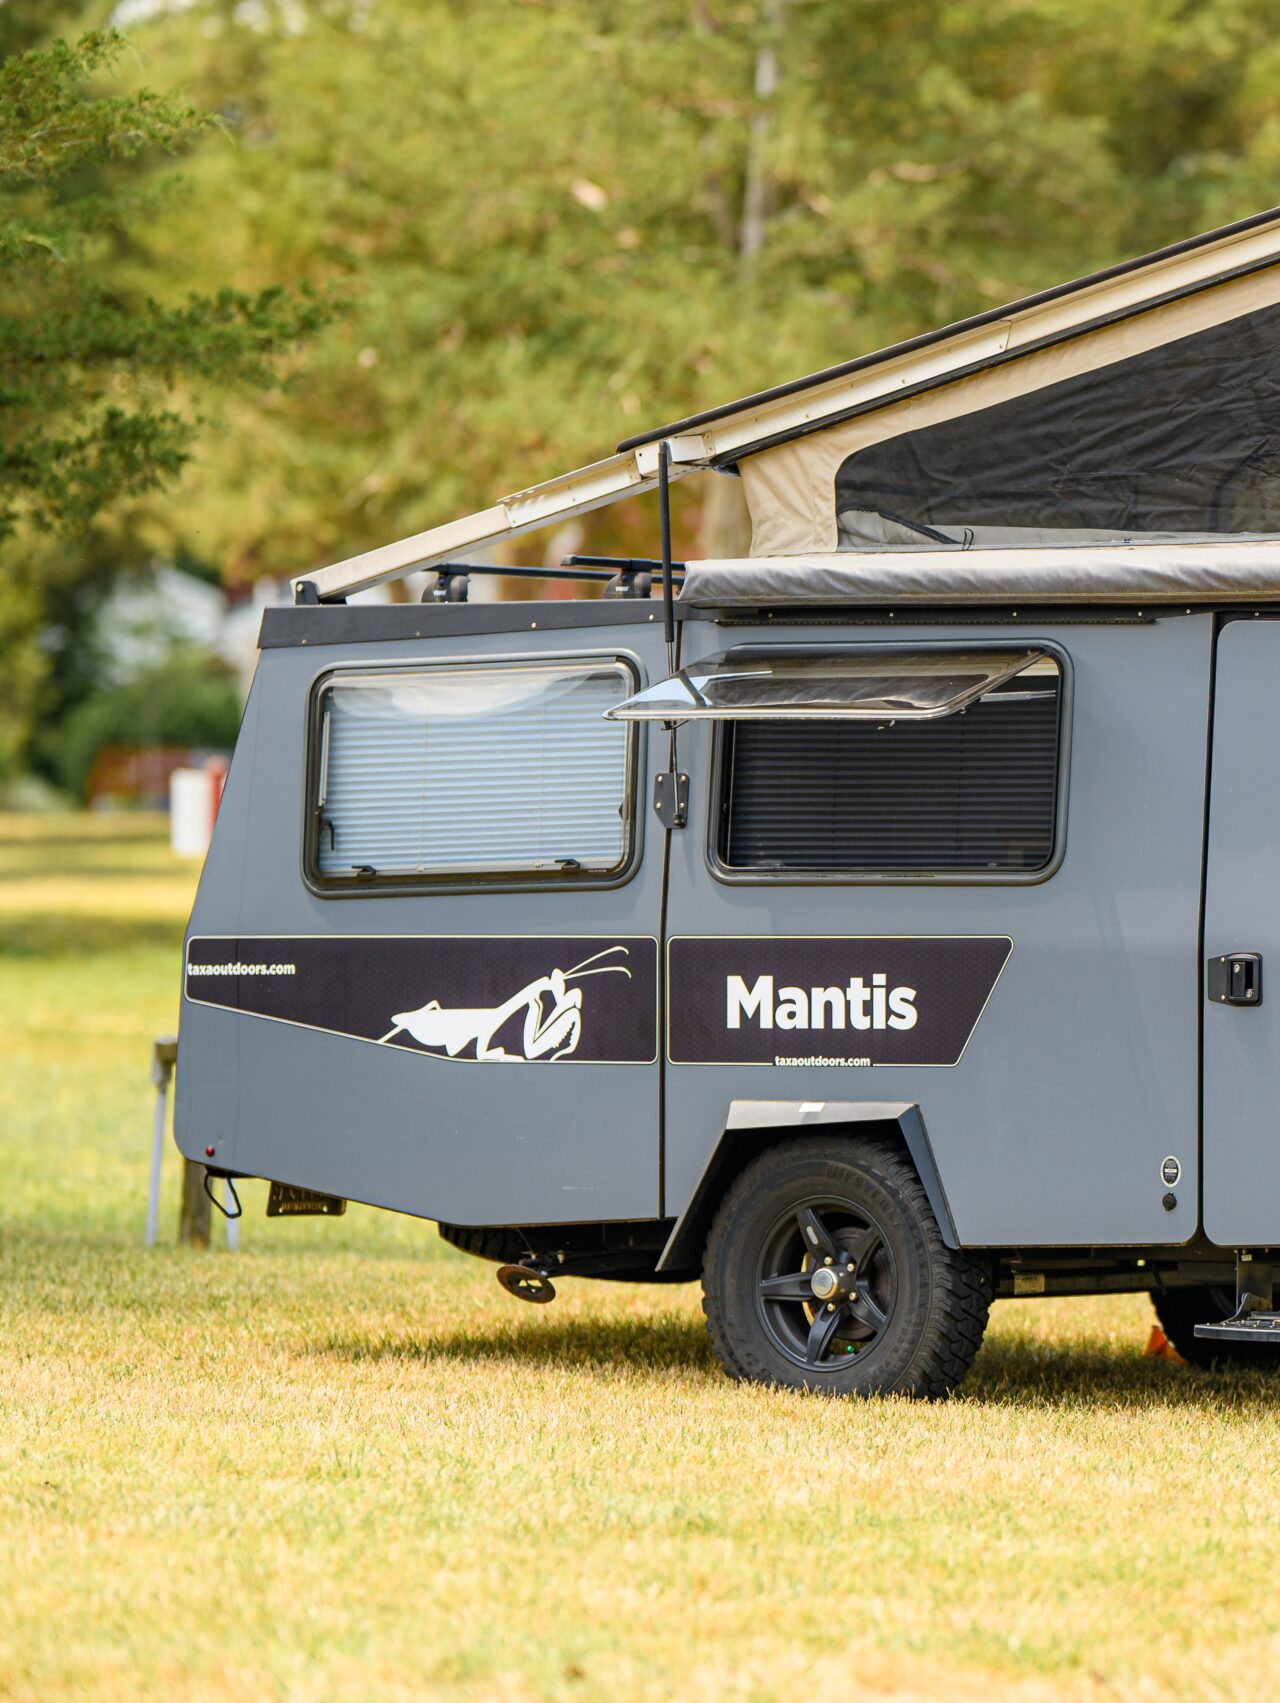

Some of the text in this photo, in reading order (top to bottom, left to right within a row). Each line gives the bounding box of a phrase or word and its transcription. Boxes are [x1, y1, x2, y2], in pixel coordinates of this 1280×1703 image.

[187, 962, 296, 976] taxaoutdoors.com
[726, 973, 918, 1030] Mantis
[775, 1056, 871, 1067] taxaoutdoors.com
